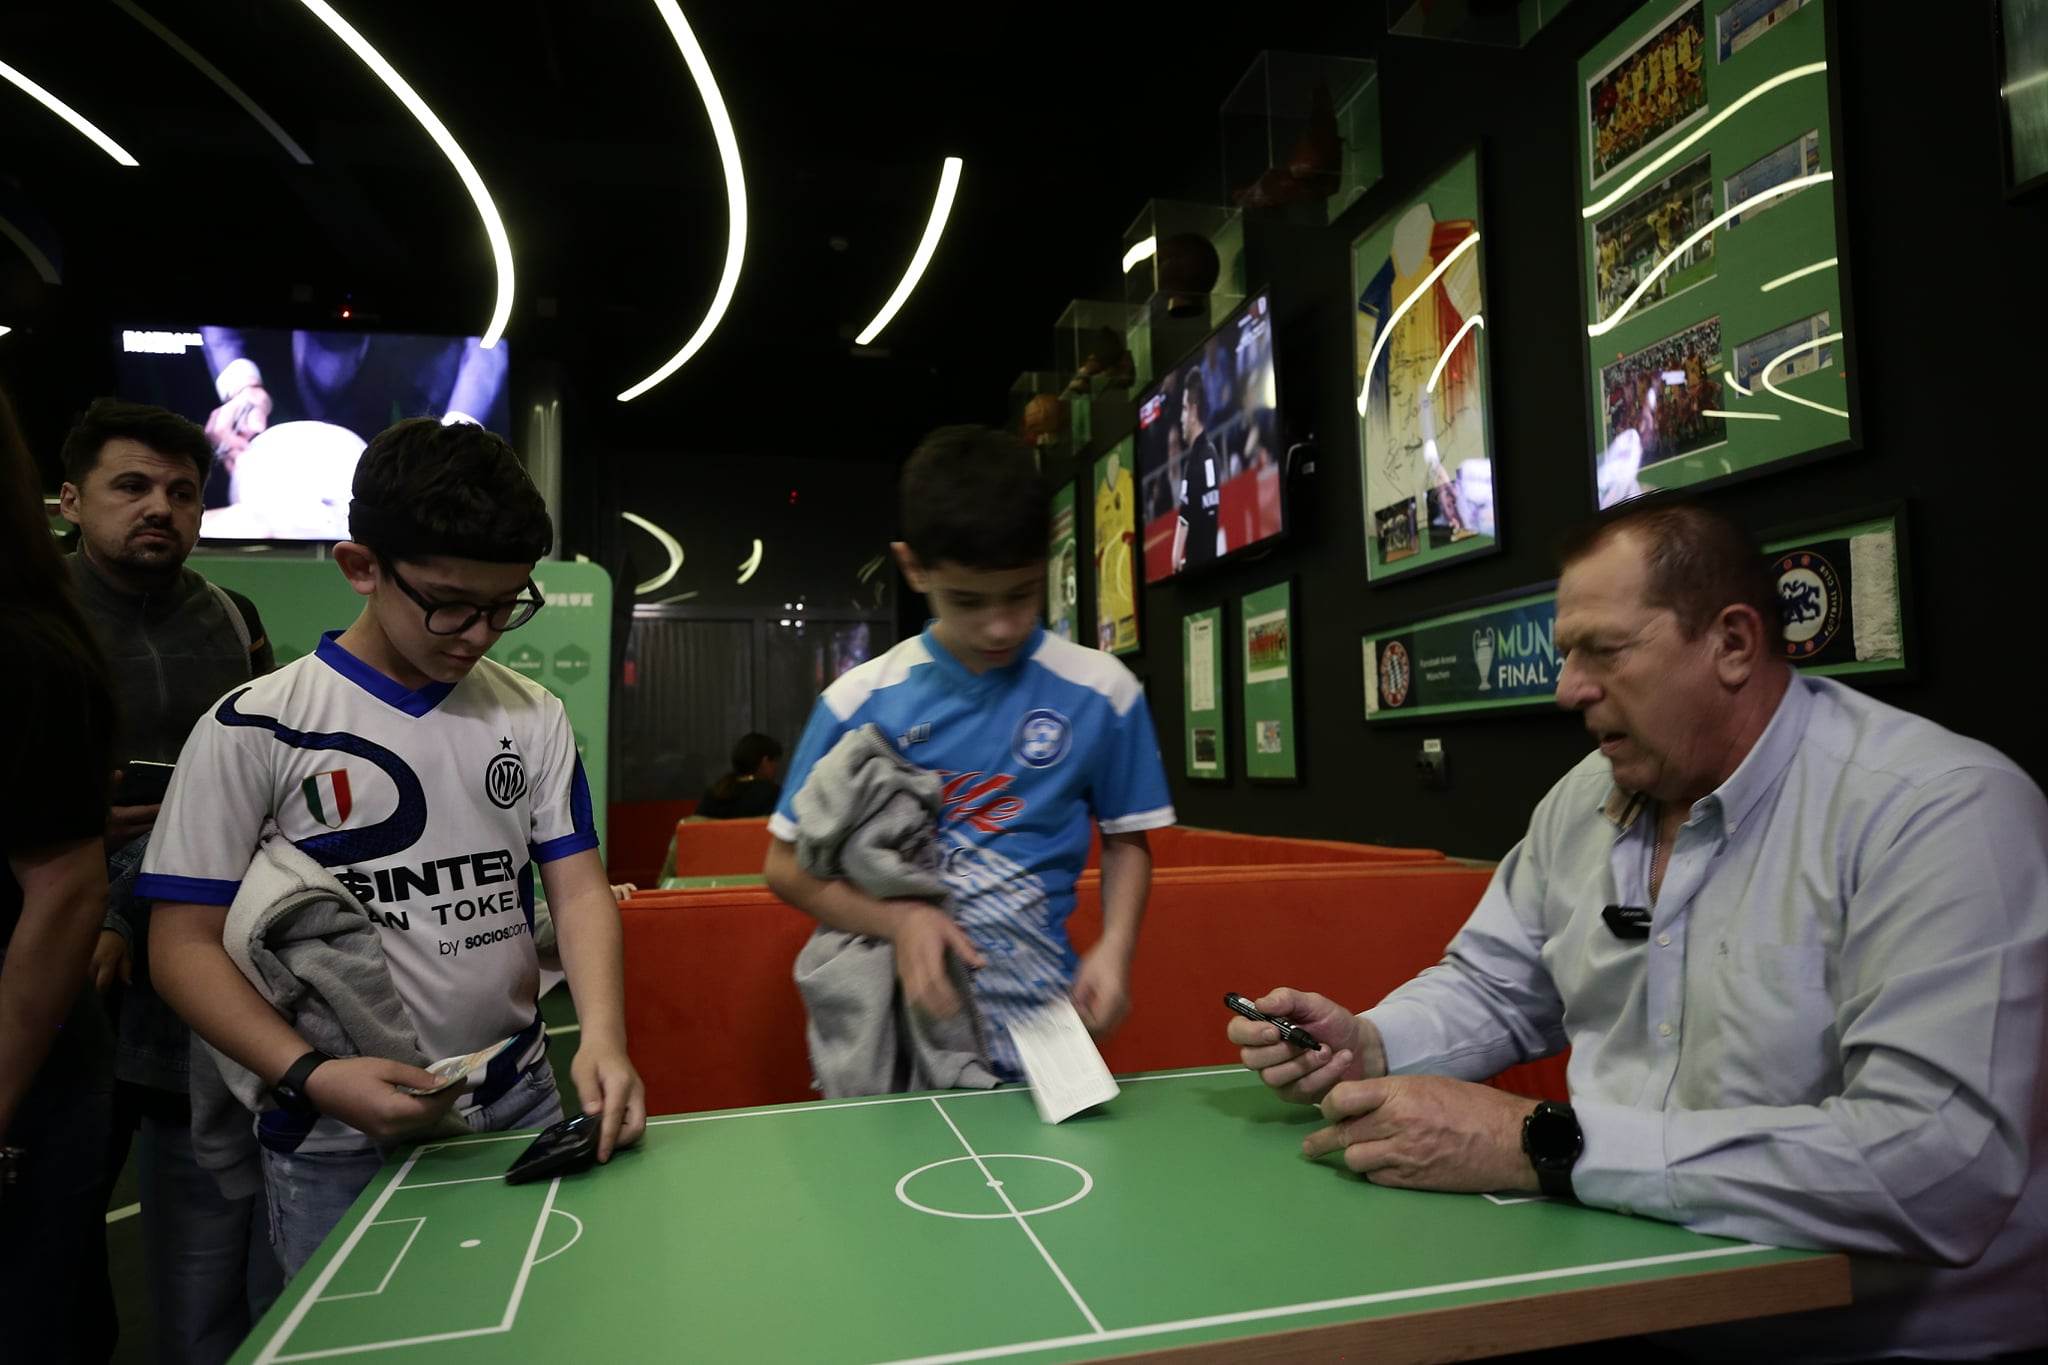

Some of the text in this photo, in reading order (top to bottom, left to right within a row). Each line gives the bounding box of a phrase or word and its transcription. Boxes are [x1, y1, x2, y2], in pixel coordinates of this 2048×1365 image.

[1497, 617, 1554, 667] MUN
[1498, 660, 1549, 690] FINAL
[368, 911, 410, 931] AN
[439, 940, 460, 956] by
